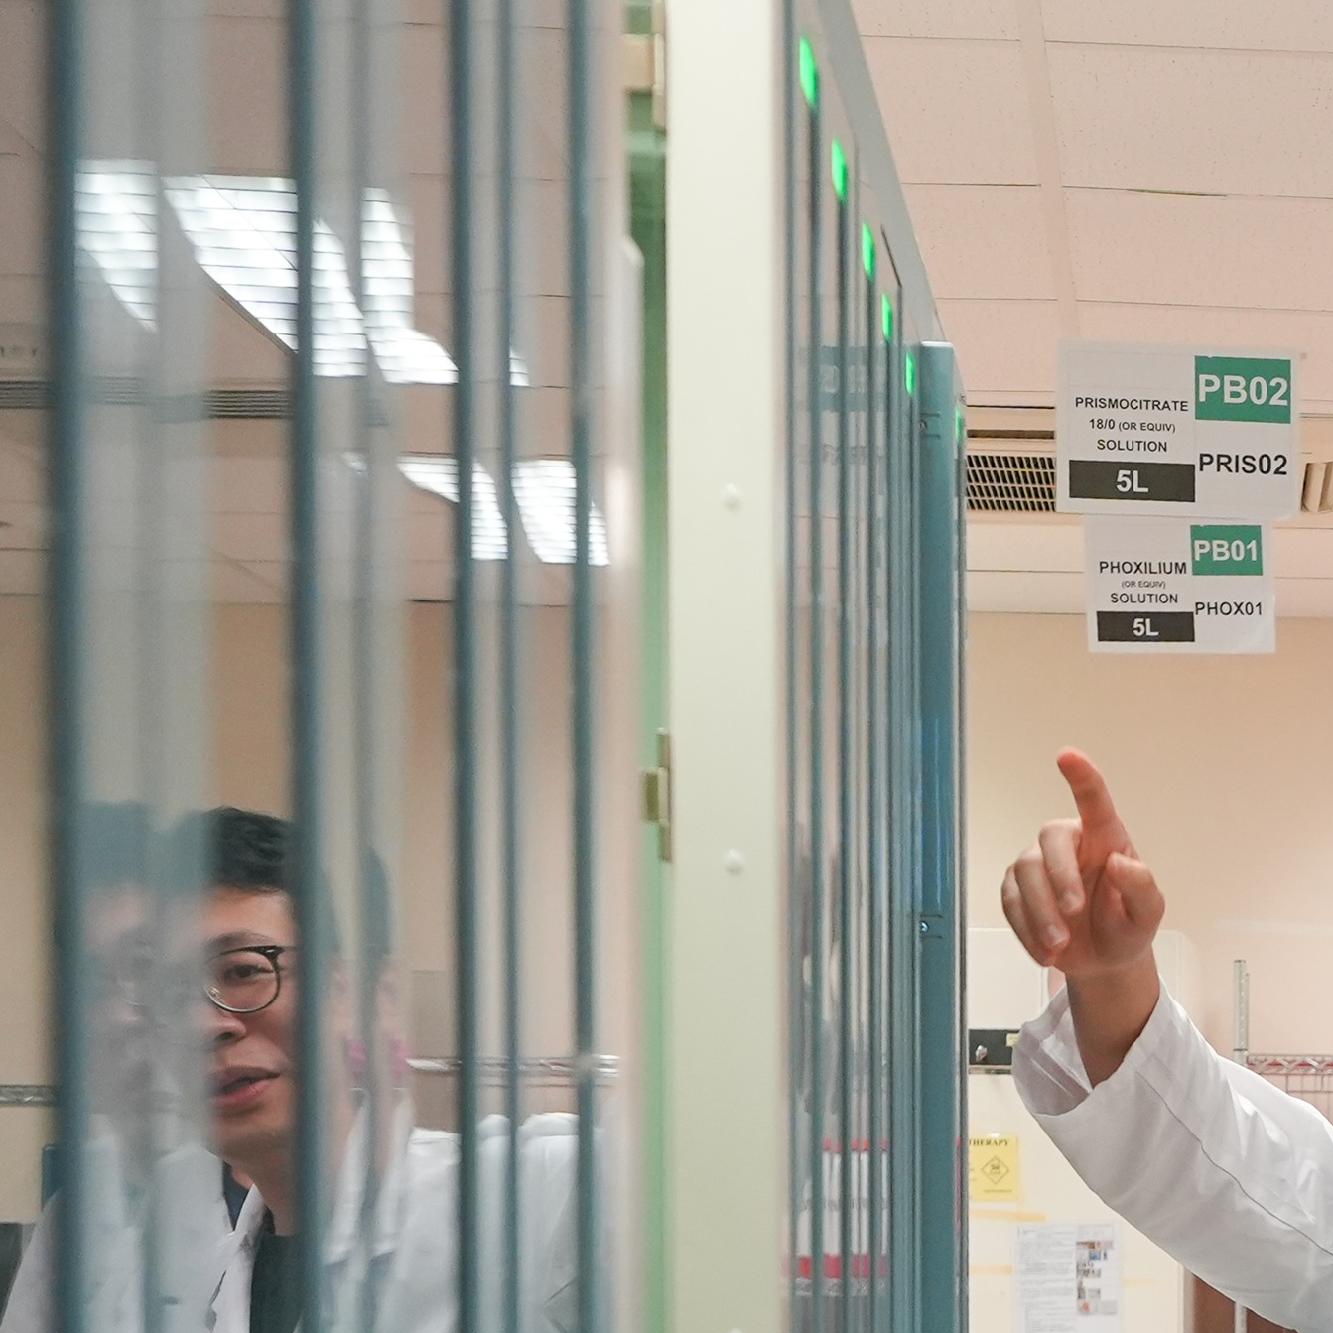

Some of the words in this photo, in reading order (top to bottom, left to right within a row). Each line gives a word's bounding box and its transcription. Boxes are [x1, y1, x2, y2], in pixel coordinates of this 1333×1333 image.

[1198, 374, 1288, 406] PB02
[1075, 397, 1189, 412] PRISMOCITRATE
[1089, 418, 1116, 431] 18/0
[1118, 421, 1137, 432] (OR
[1139, 422, 1176, 434] EQUIV)
[1097, 439, 1167, 453] SOLUTION
[1198, 453, 1288, 475] PRIS02
[1116, 470, 1149, 493] 5L
[1193, 539, 1258, 561] PB01
[1099, 561, 1187, 575] PHOXILIUM
[1110, 592, 1178, 604] SOLUTION
[1195, 601, 1263, 616] PHOX01
[1132, 618, 1159, 636] 5L
